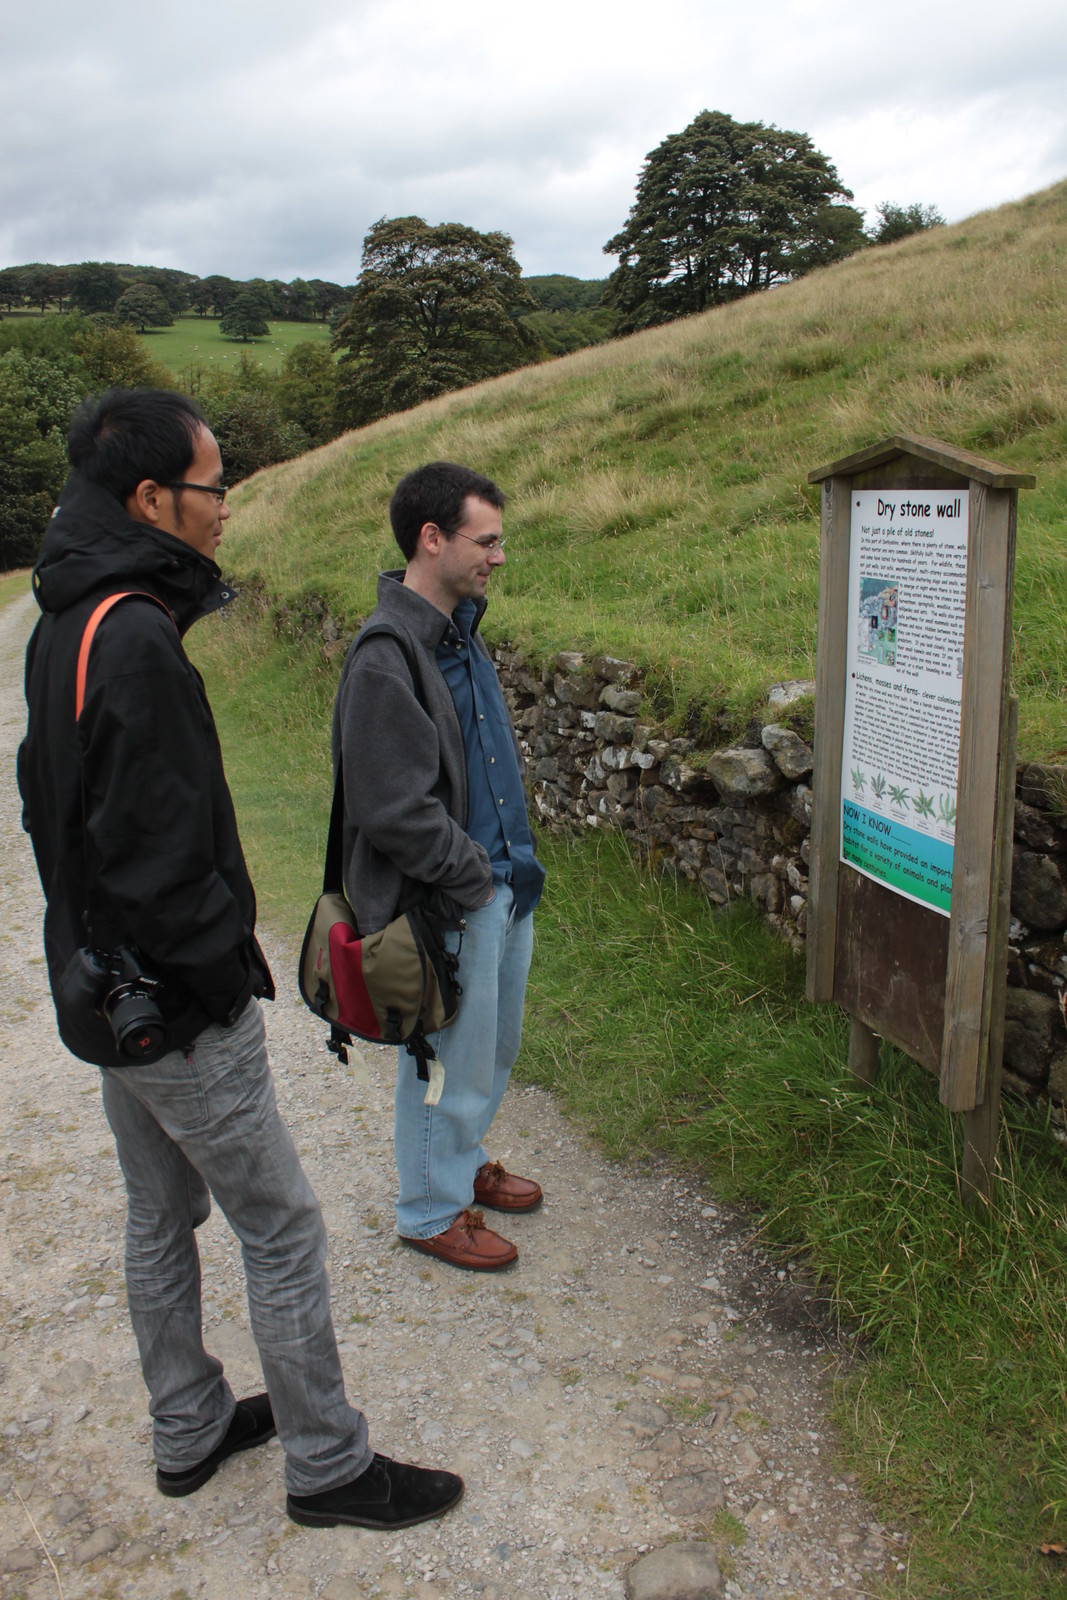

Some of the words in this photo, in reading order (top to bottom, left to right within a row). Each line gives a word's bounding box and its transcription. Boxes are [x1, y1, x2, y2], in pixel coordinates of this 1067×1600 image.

[878, 499, 895, 520] Dry
[900, 501, 930, 516] stone
[937, 499, 960, 517] wall
[871, 528, 880, 536] just
[887, 527, 895, 537] pile
[905, 528, 913, 536] old
[139, 976, 158, 985] SONY
